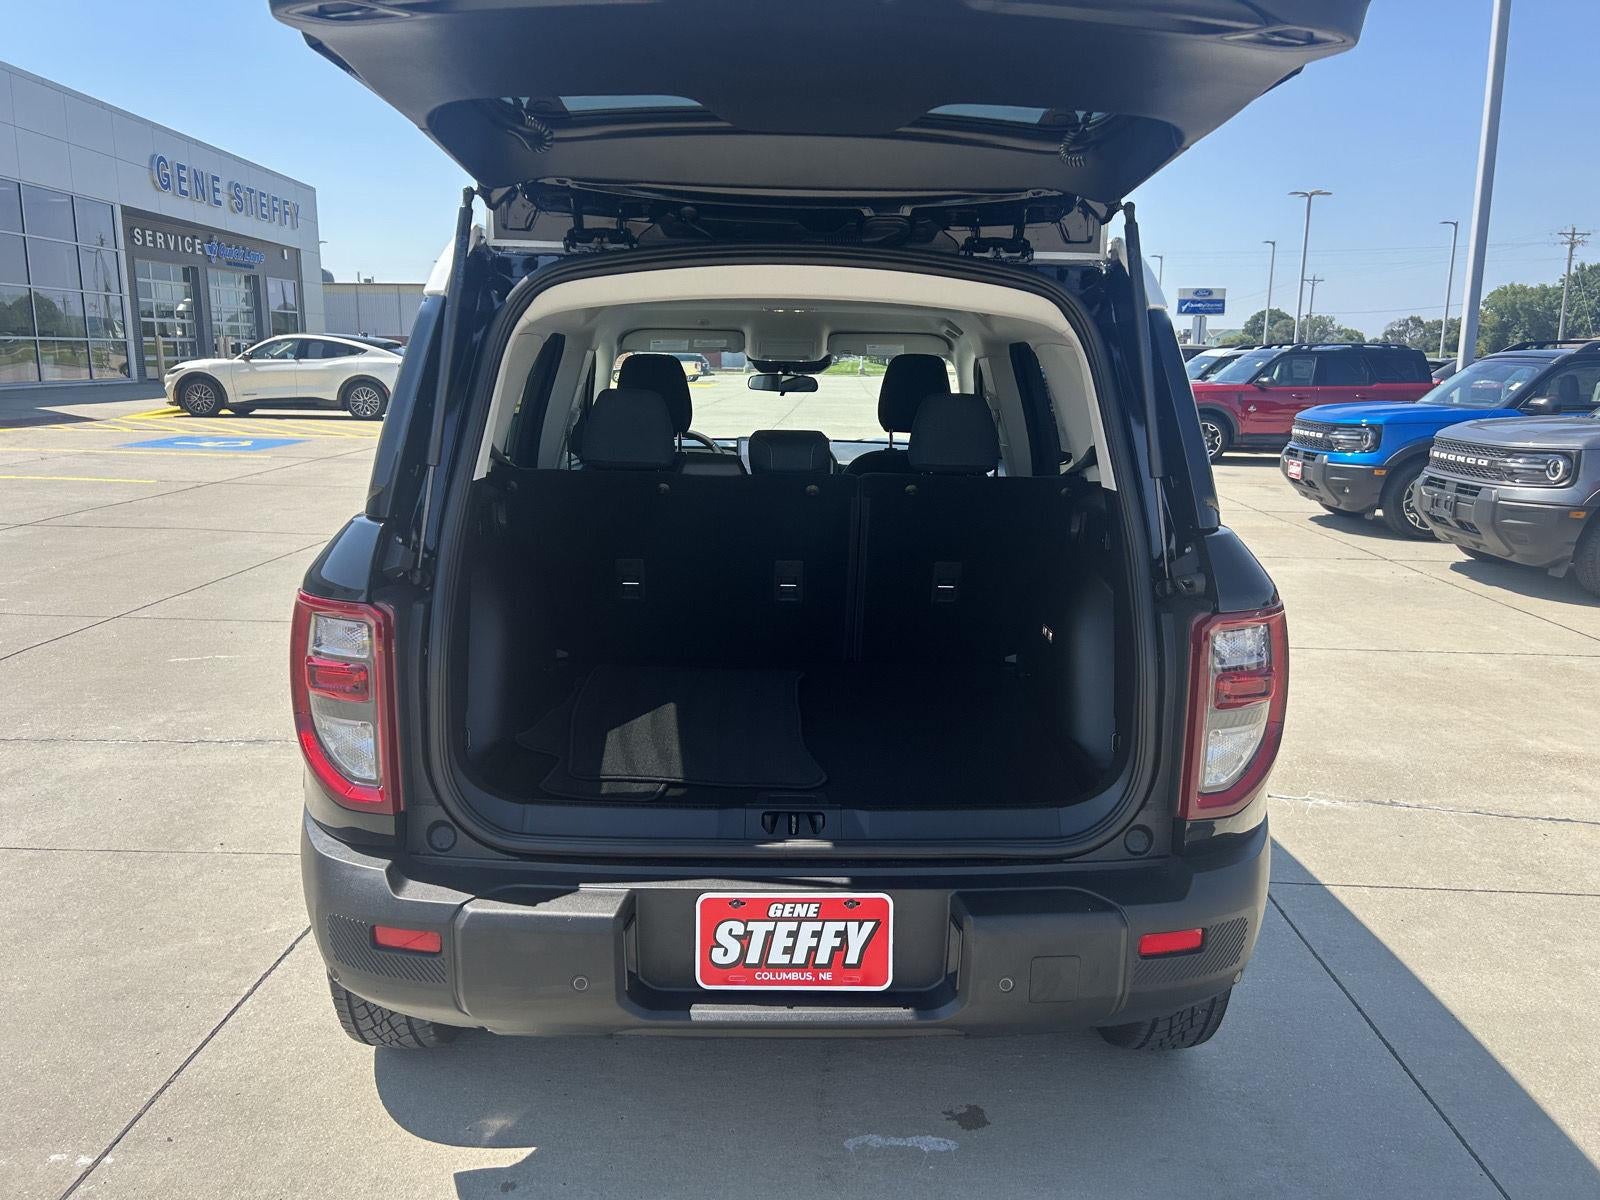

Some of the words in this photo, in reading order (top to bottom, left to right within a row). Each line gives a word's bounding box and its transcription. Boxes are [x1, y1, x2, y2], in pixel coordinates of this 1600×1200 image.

[152, 152, 223, 208] GENE
[229, 180, 300, 230] STEFFY
[133, 227, 203, 255] SERVICE
[1433, 451, 1489, 466] BRONCO
[767, 902, 821, 918] GENE
[710, 919, 879, 968] STEFFY
[754, 971, 815, 982] COLUMBUS,
[818, 971, 833, 981] NE
